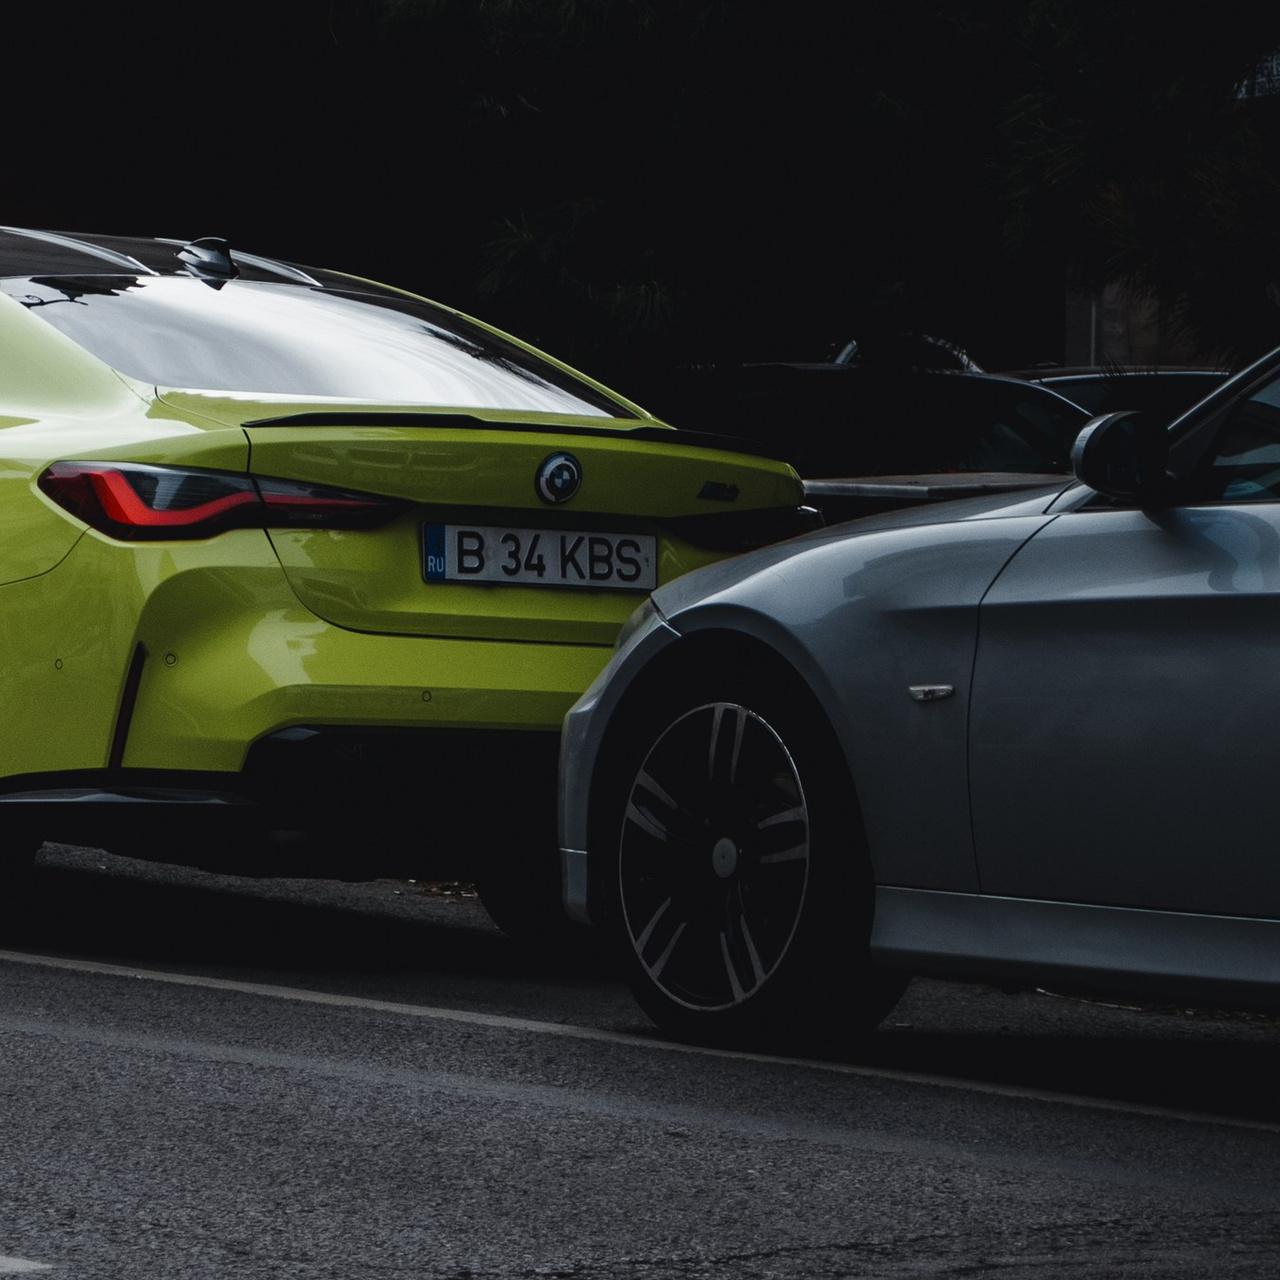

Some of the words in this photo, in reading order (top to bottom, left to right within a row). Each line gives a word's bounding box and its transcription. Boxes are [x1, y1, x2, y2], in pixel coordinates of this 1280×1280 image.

[457, 530, 485, 574] B
[500, 533, 546, 577] 34
[560, 535, 642, 582] KBS
